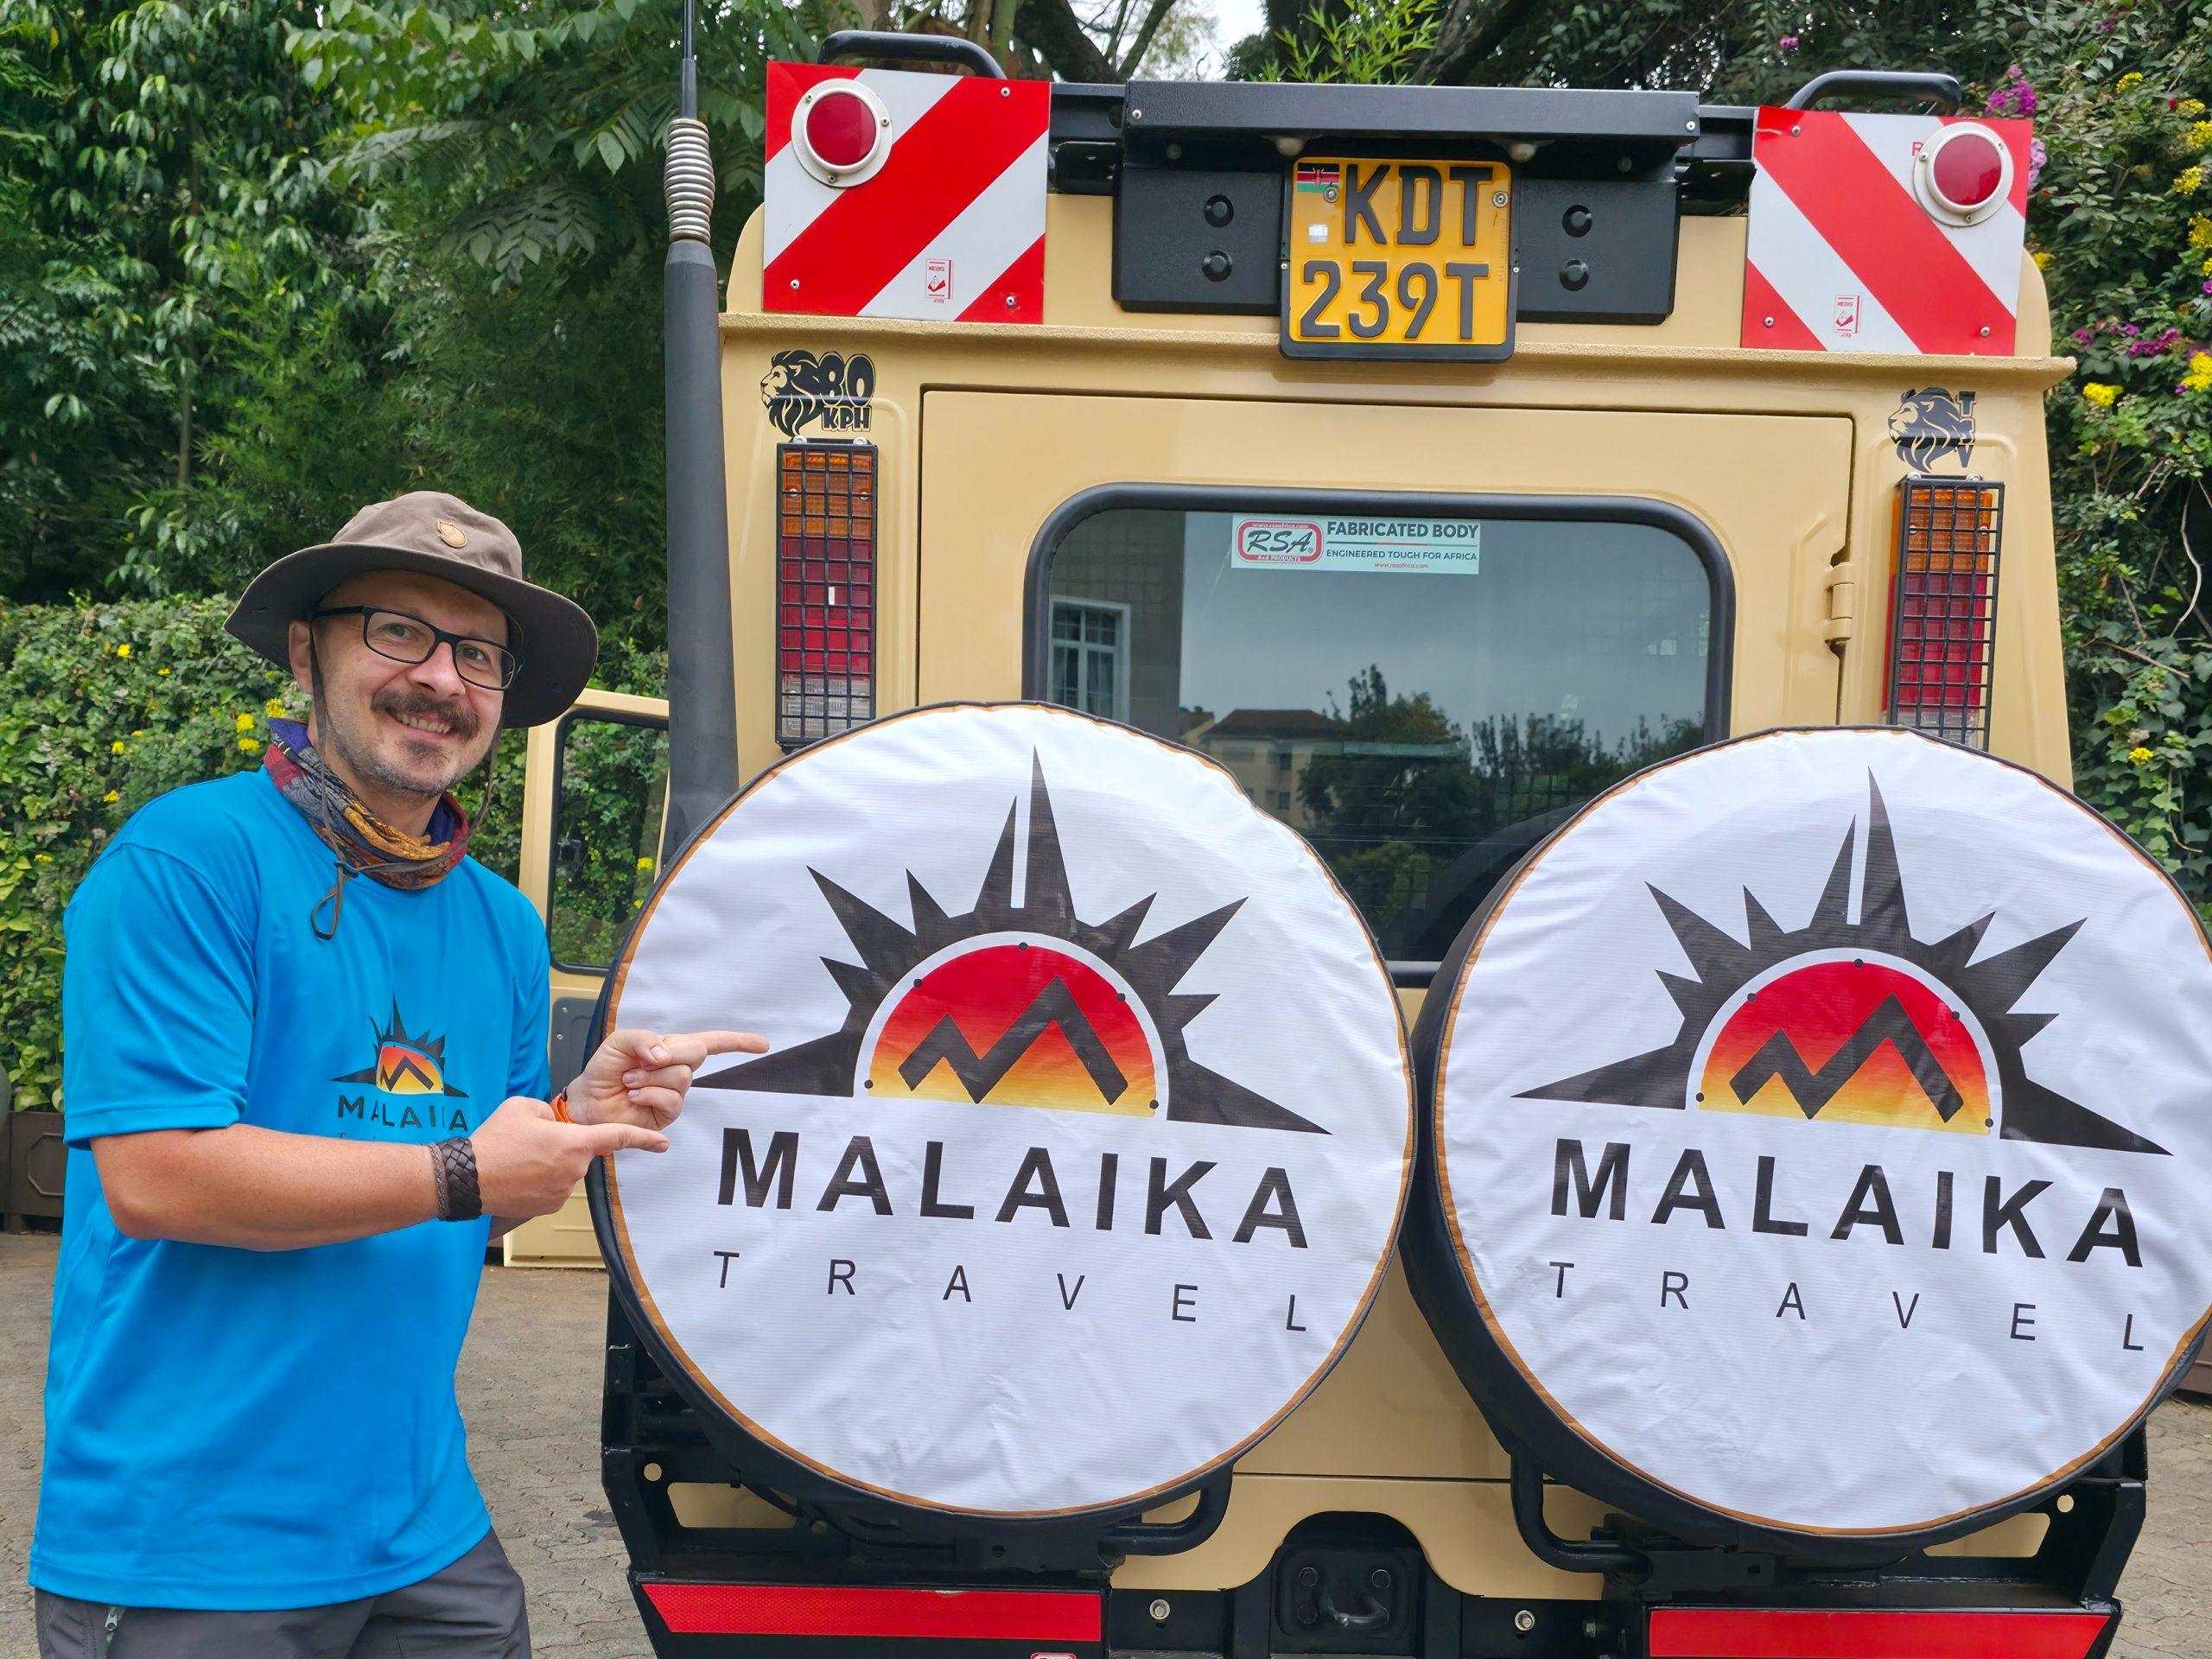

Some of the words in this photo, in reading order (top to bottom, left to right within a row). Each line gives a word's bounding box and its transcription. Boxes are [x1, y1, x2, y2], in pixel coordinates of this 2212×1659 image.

[1344, 163, 1494, 247] KDT
[1300, 259, 1490, 342] 239T
[817, 351, 875, 406] 80
[821, 404, 872, 432] KPH
[1326, 521, 1429, 537] FABRICATED
[1432, 524, 1479, 539] BODY
[1326, 550, 1386, 559] ENGINEERED
[1388, 551, 1421, 560] TOUGH
[1443, 553, 1478, 562] AFRICA
[717, 1127, 1308, 1249] MALAIKA
[1551, 1138, 2143, 1268] MALAIKA
[713, 1250, 1306, 1333] TRAVEL
[1549, 1262, 2145, 1352] TRAVEL
